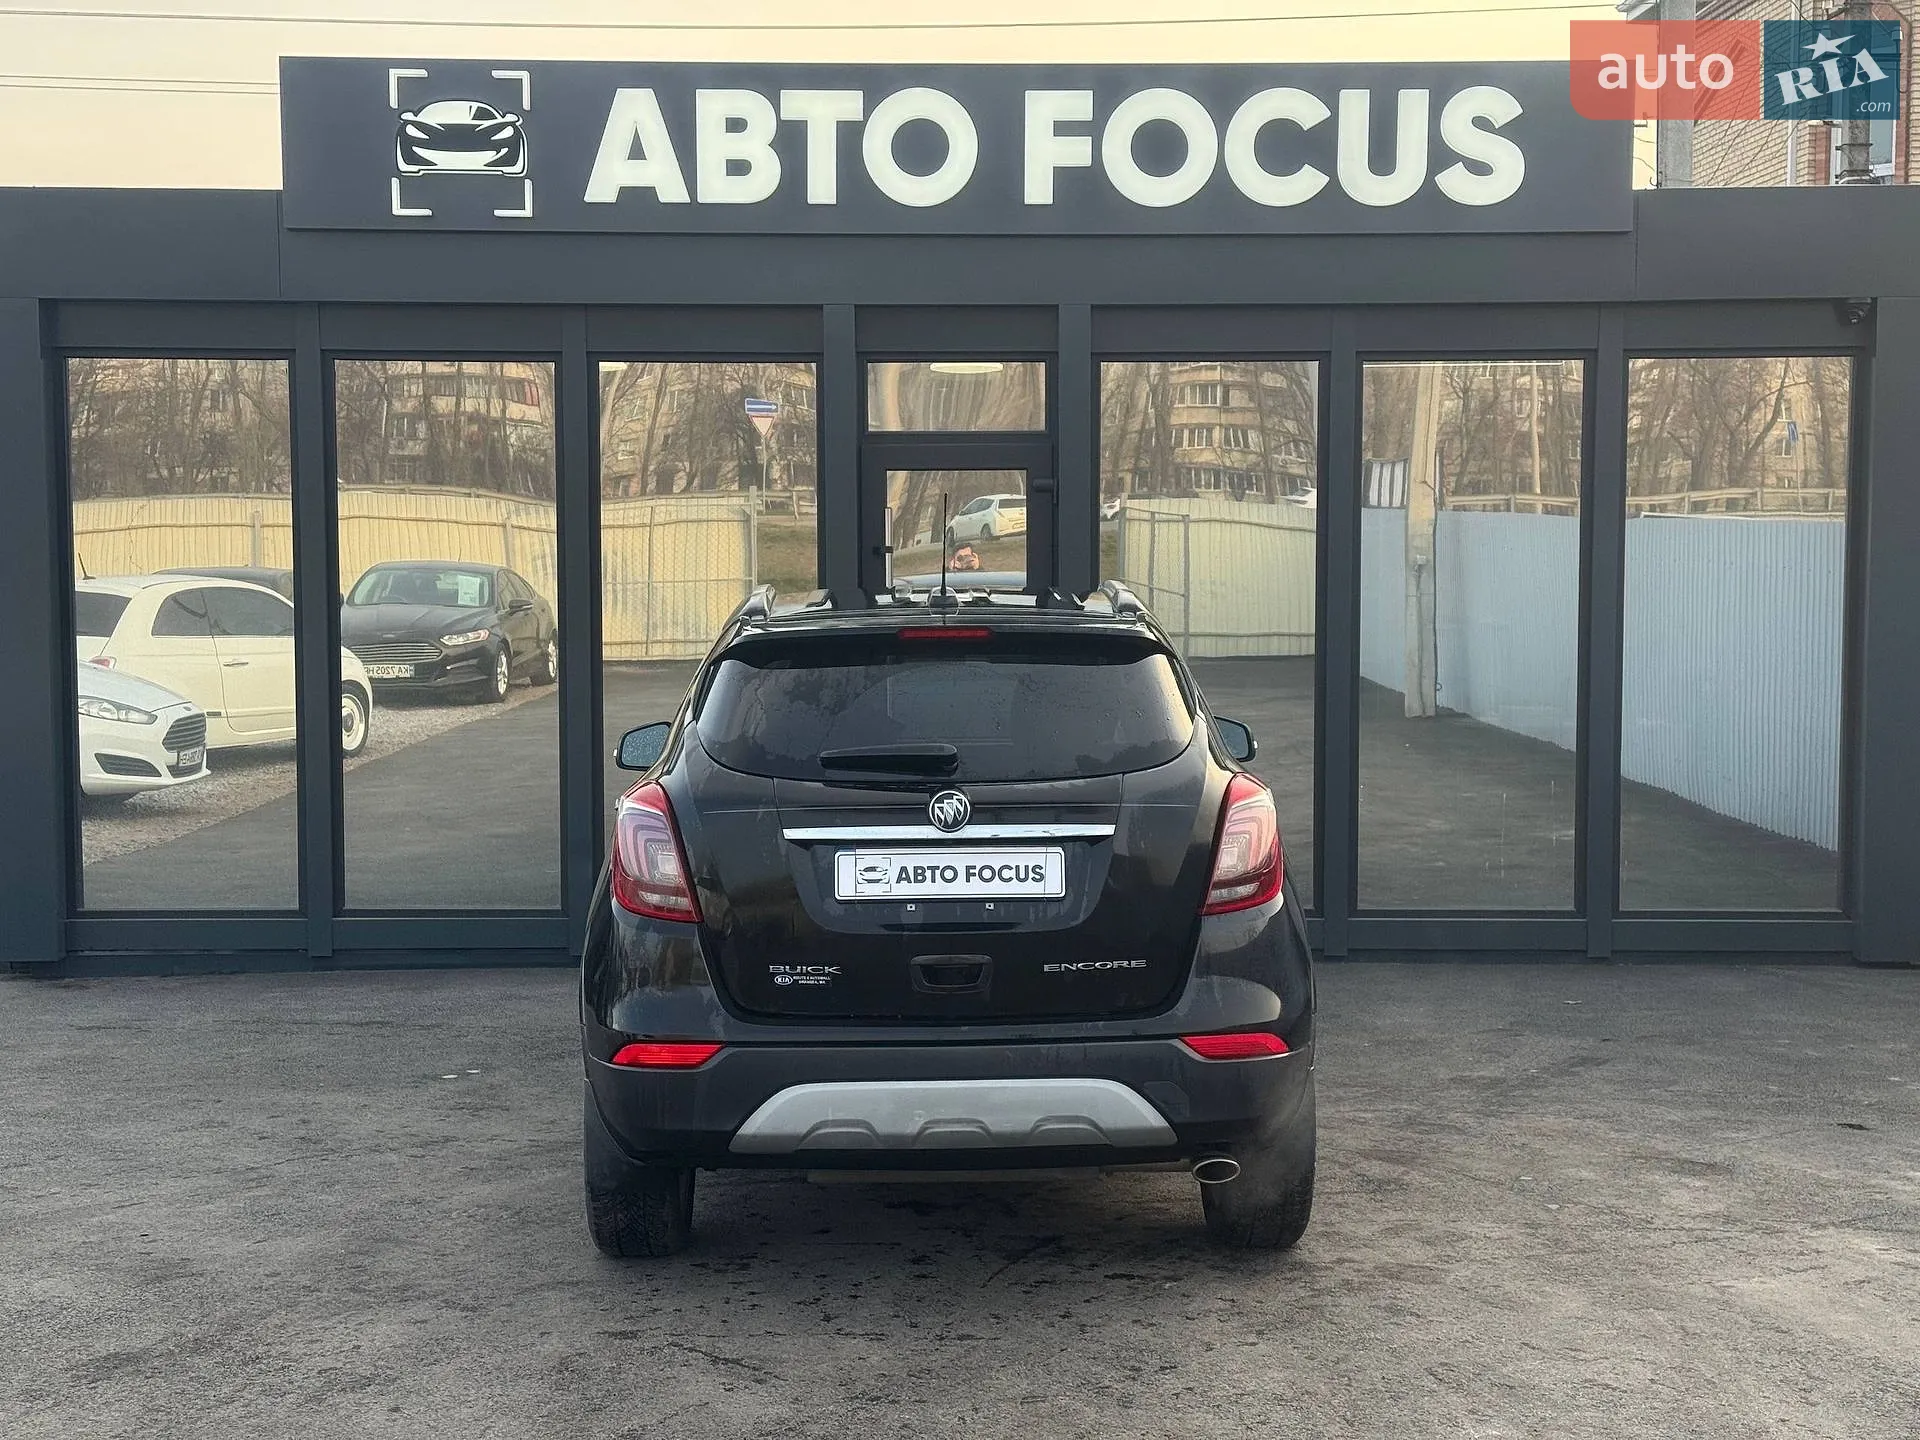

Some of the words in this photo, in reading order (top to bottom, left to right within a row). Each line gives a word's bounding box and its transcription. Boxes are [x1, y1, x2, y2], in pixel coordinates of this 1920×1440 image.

[583, 87, 979, 207] АВТО
[1024, 86, 1525, 207] FOCUS
[896, 865, 958, 884] АВТО
[965, 864, 1044, 883] FOCUS
[769, 965, 842, 975] BUICK
[1043, 959, 1147, 972] ENCORE
